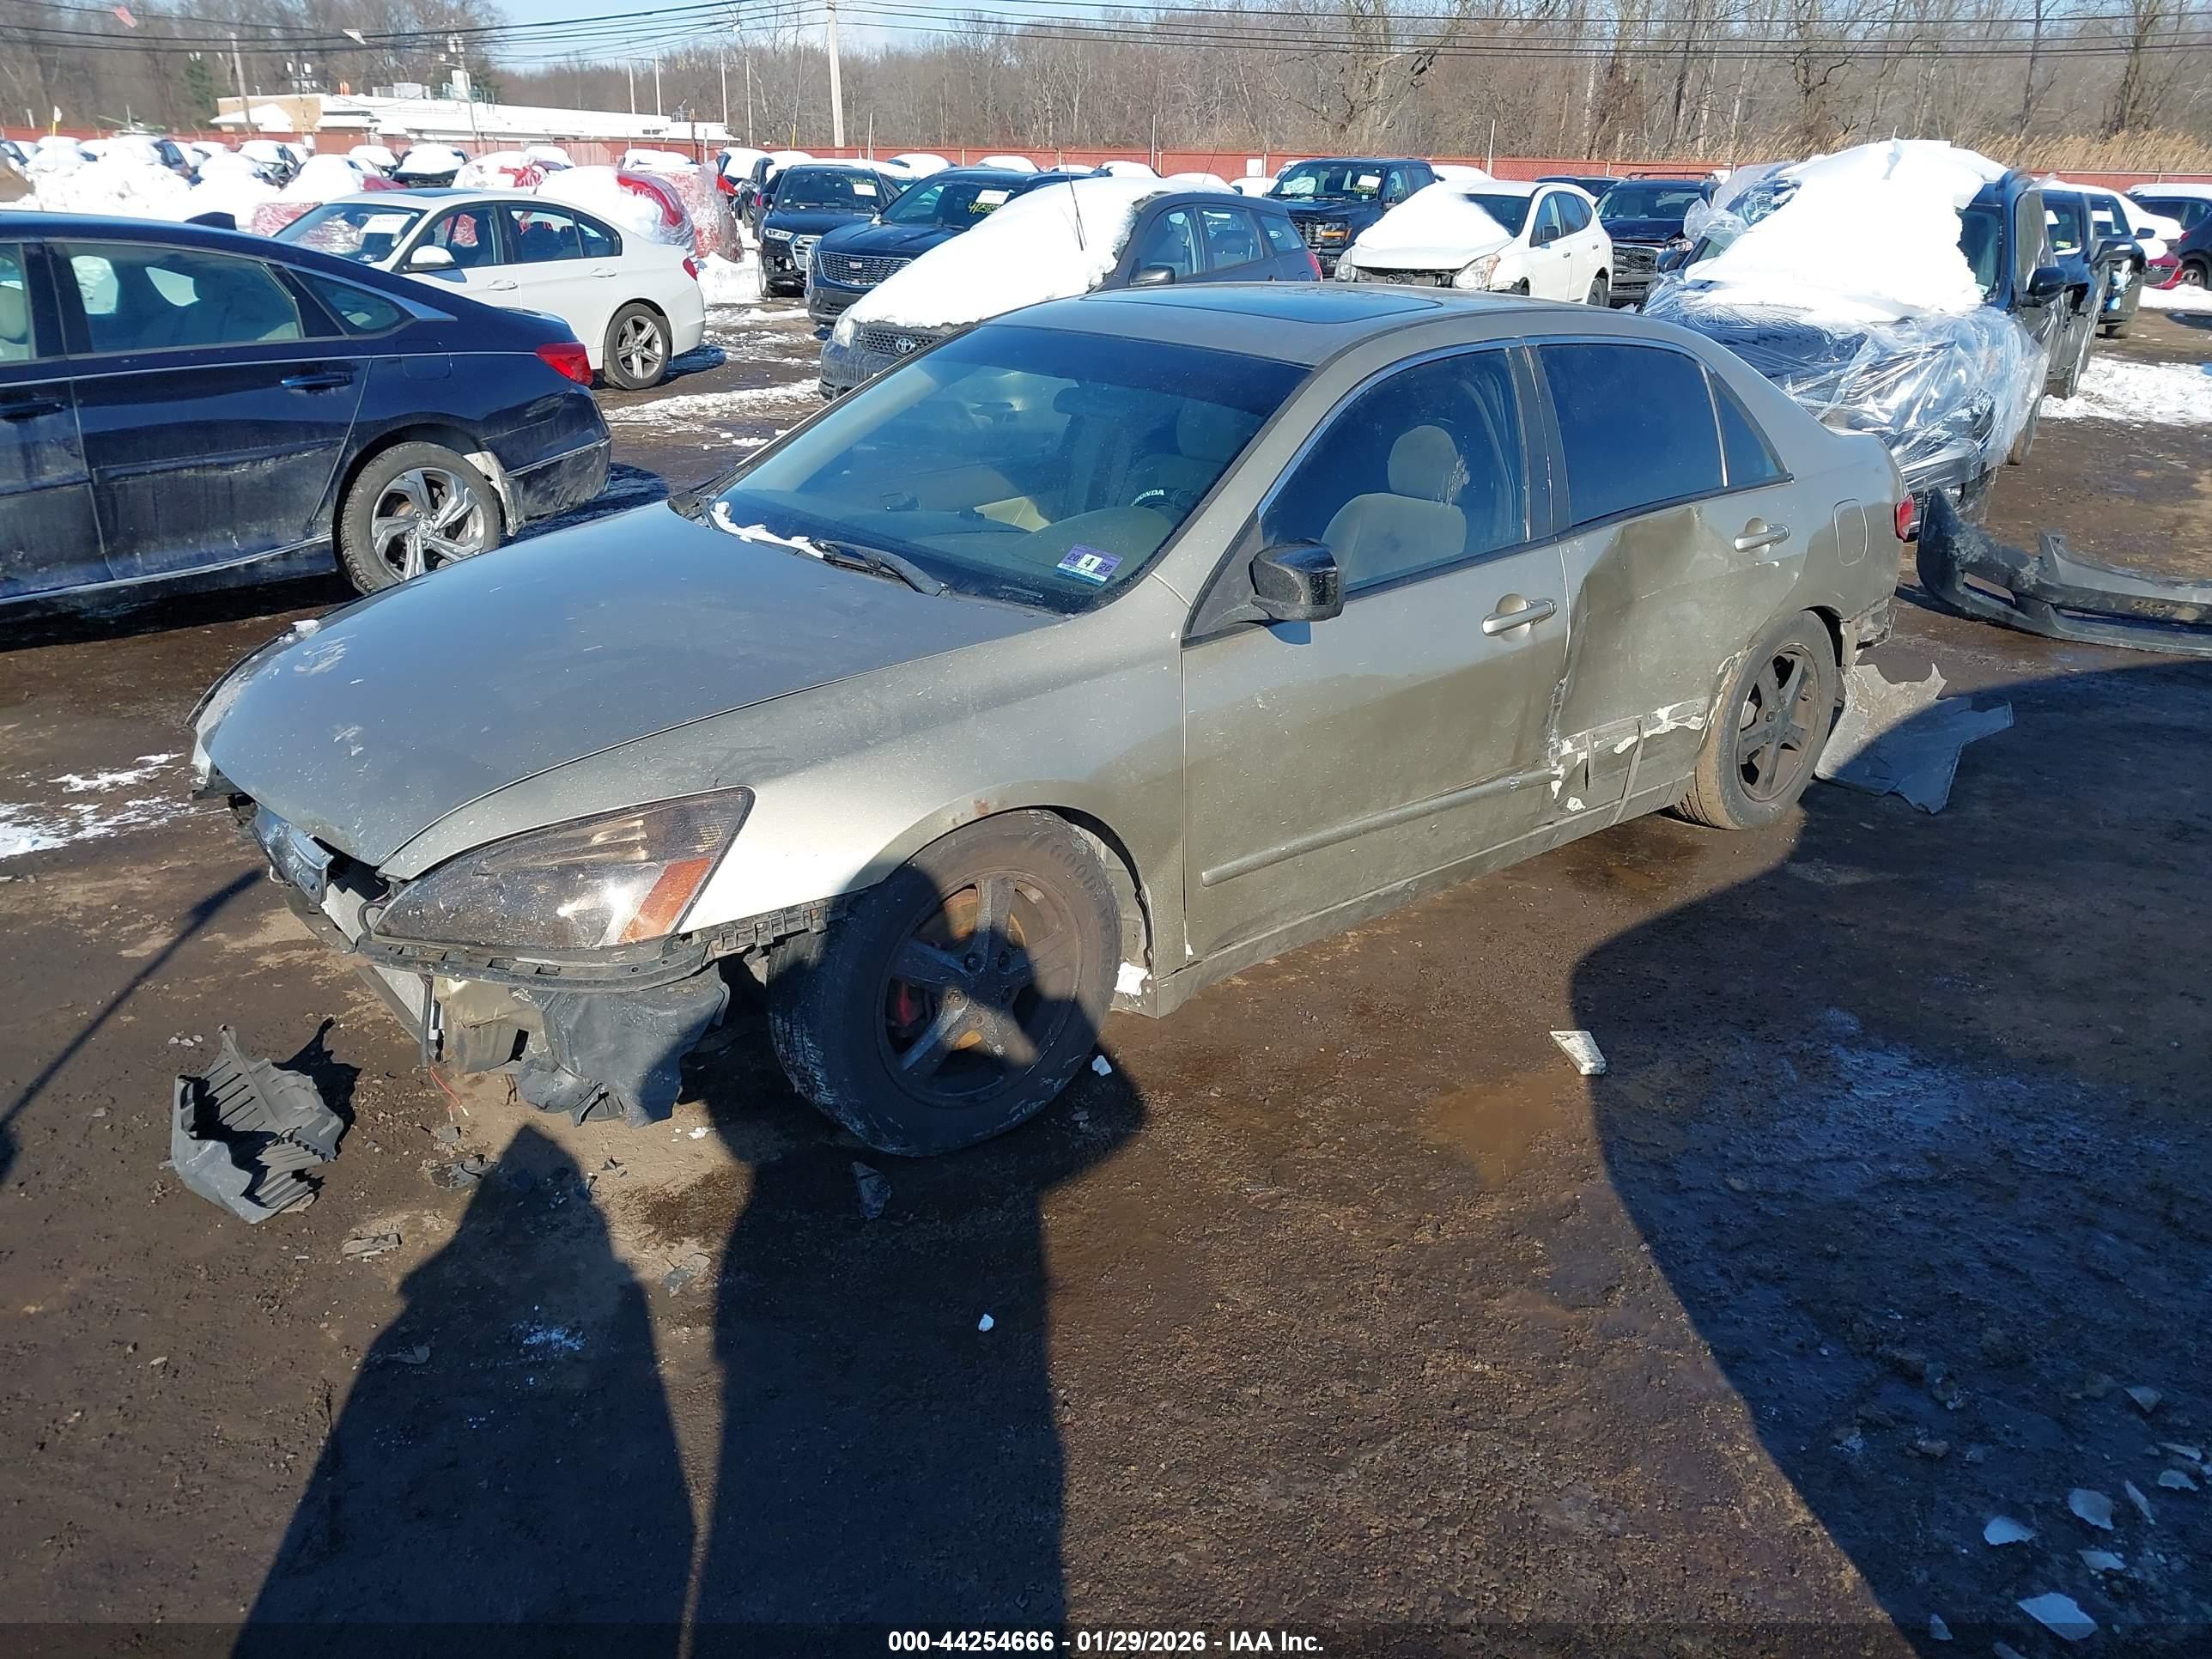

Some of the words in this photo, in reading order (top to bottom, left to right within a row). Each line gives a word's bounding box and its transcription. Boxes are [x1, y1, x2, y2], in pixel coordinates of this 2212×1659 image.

[1134, 489, 1165, 505] HONDA
[1067, 553, 1080, 562] 20
[1085, 557, 1094, 568] 4
[1098, 563, 1113, 573] 26
